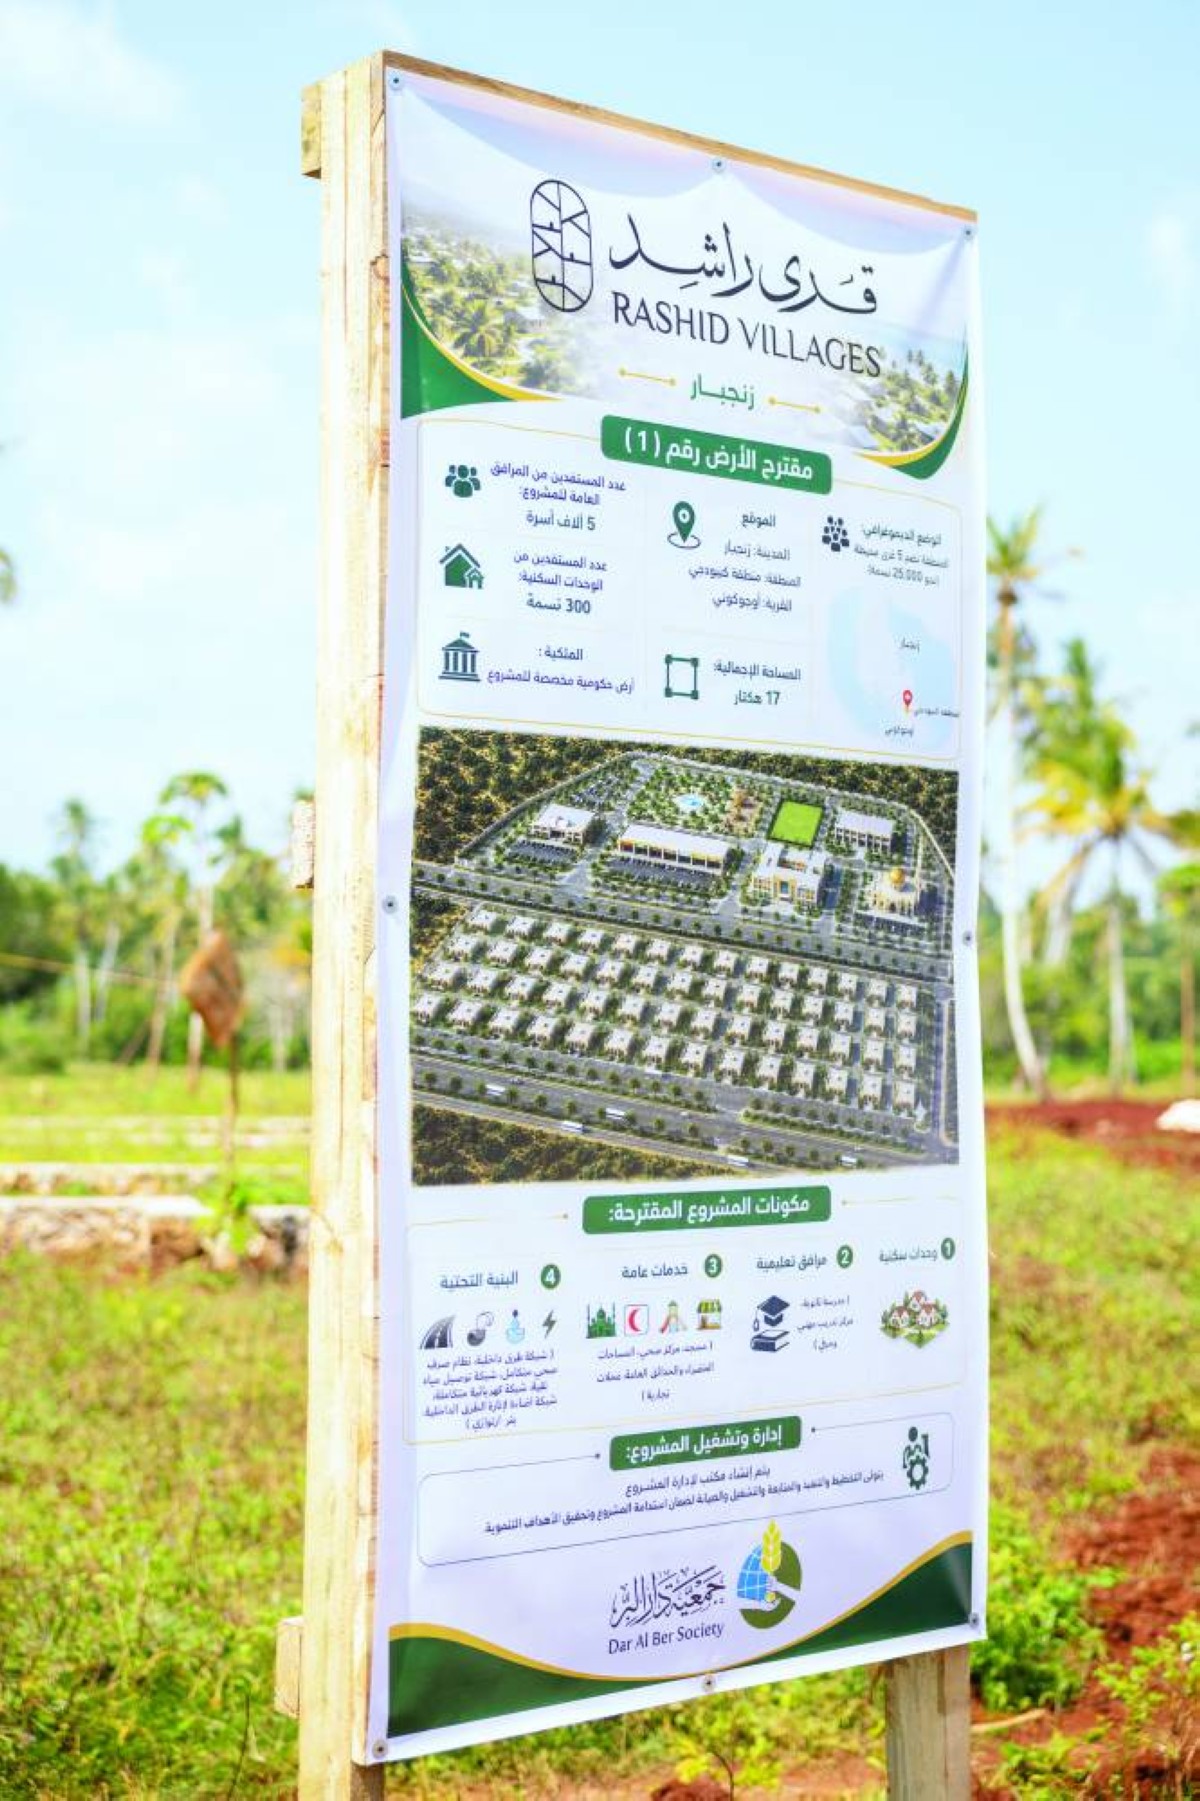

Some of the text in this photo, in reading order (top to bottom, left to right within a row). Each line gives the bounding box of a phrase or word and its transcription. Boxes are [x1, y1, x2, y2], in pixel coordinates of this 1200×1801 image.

[611, 290, 882, 378] RASHID VILLAGES
[690, 373, 755, 410] زنجبار
[665, 438, 701, 467] رقم
[705, 444, 757, 474] الأرض
[490, 462, 529, 477] المرافق
[531, 470, 548, 482] من
[761, 456, 813, 481] مقترح
[607, 480, 627, 492] عدد
[569, 491, 601, 506] العامة
[526, 508, 554, 527] أسرة
[587, 516, 597, 531] 5
[741, 512, 776, 529] الموقع
[513, 552, 529, 565] من
[589, 561, 608, 572] عدد
[563, 578, 604, 594] الوحدات
[526, 593, 592, 614] 300 نسمة
[762, 664, 801, 681] المساحة
[487, 669, 635, 695] أرض حكومية مخصصة للمشروع
[733, 689, 781, 706] 17 هكتار
[686, 1195, 751, 1224] المشروع
[754, 1194, 811, 1219] مكونات
[650, 1262, 688, 1278] خدمات
[756, 1256, 796, 1272] تعليمية
[798, 1253, 828, 1271] مرافق
[486, 1269, 518, 1289] البنية
[621, 1265, 648, 1279] عامة
[439, 1272, 483, 1291] التحتية
[693, 1427, 750, 1456] وتشغيل
[751, 1424, 783, 1448] إدارة
[625, 1475, 670, 1498] المشروع
[699, 1469, 726, 1486] مكتب
[608, 1621, 726, 1655] Dar Al Ber Society
